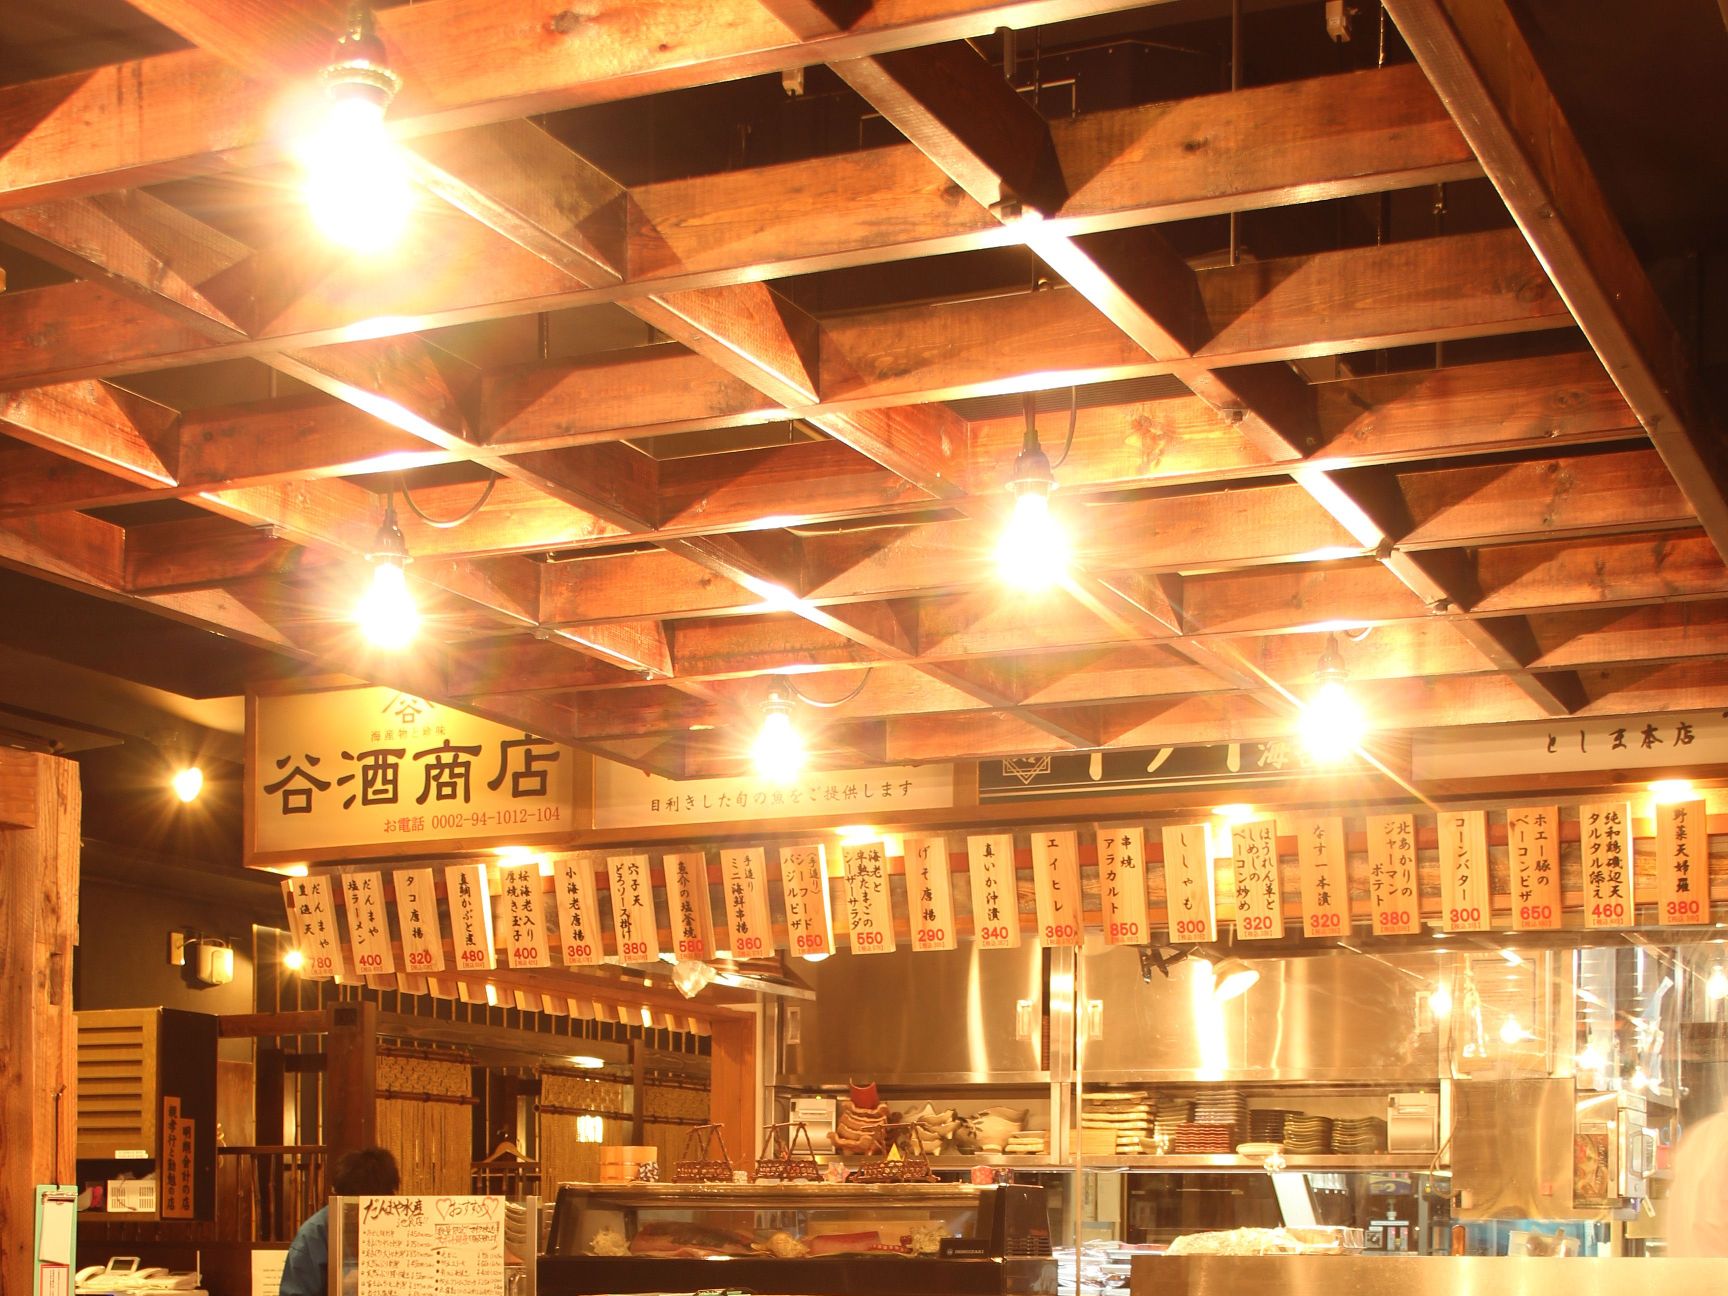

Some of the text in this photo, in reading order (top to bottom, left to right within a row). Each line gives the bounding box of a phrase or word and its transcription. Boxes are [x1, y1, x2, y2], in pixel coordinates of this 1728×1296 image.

[263, 735, 560, 815] 谷酒商店
[650, 780, 913, 813] 目利きした旬の魚をご提供します
[383, 807, 560, 833] お電話 0002-94-1012-104
[867, 850, 882, 893] 海老と
[1120, 835, 1136, 869] 串焼
[1247, 829, 1261, 882] しめじの
[1259, 828, 1276, 911] ほうれん草と
[1312, 825, 1331, 906] なす一本漬
[1383, 822, 1399, 896] ジャーマン
[1397, 822, 1413, 898] 北あかりの
[1455, 818, 1471, 901] コーンバター
[1516, 815, 1532, 903] ベーコンピザ
[1534, 814, 1552, 886] ホエー豚の
[1589, 813, 1605, 900] タルタル添え
[1673, 808, 1690, 893] 野菜天婦羅
[627, 864, 644, 907] 穴子天
[743, 855, 756, 893] 手造り
[795, 854, 813, 931] シーフード
[844, 852, 862, 930] シーザーサラダ
[856, 851, 873, 928] 半熟たまごの
[918, 845, 936, 922] げそ唐揚
[983, 843, 1000, 921] 真いか沖漬
[1047, 838, 1063, 912] エイヒレ
[1103, 838, 1120, 914] アラカルト
[1181, 833, 1193, 911] ししゃも
[1233, 832, 1251, 912] ベーコン炒め
[1371, 864, 1385, 907] ポテト
[312, 883, 330, 949] だんまや
[348, 879, 366, 945] 塩ラーメン
[362, 879, 379, 937] だんまや
[405, 875, 424, 939] タコ唐揚
[505, 871, 522, 942] 厚焼き玉子
[518, 870, 535, 942] 桜海老入り
[566, 867, 585, 942] 小海老唐揚
[616, 863, 632, 941] どろソース掛け
[730, 857, 748, 935] ミニ海鮮串揚
[1450, 908, 1481, 922] 300
[1520, 906, 1552, 920] 650
[1591, 904, 1624, 917] 460
[1666, 901, 1700, 915] 380
[857, 932, 883, 945] 550
[918, 929, 945, 942] 290
[981, 927, 1008, 940] 340
[1045, 925, 1073, 938] 360
[1110, 923, 1139, 936] 850
[1176, 920, 1206, 933] 300
[1243, 917, 1273, 930] 320
[1311, 914, 1340, 928] 320
[1379, 911, 1410, 925] 380
[359, 954, 382, 966] 400
[409, 952, 432, 964] 320
[461, 950, 484, 962] 480
[513, 947, 537, 960] 400
[567, 945, 592, 957] 360
[623, 942, 647, 954] 380
[679, 940, 704, 952] 580
[736, 938, 762, 950] 360
[797, 935, 822, 947] 650
[311, 957, 332, 969] 780
